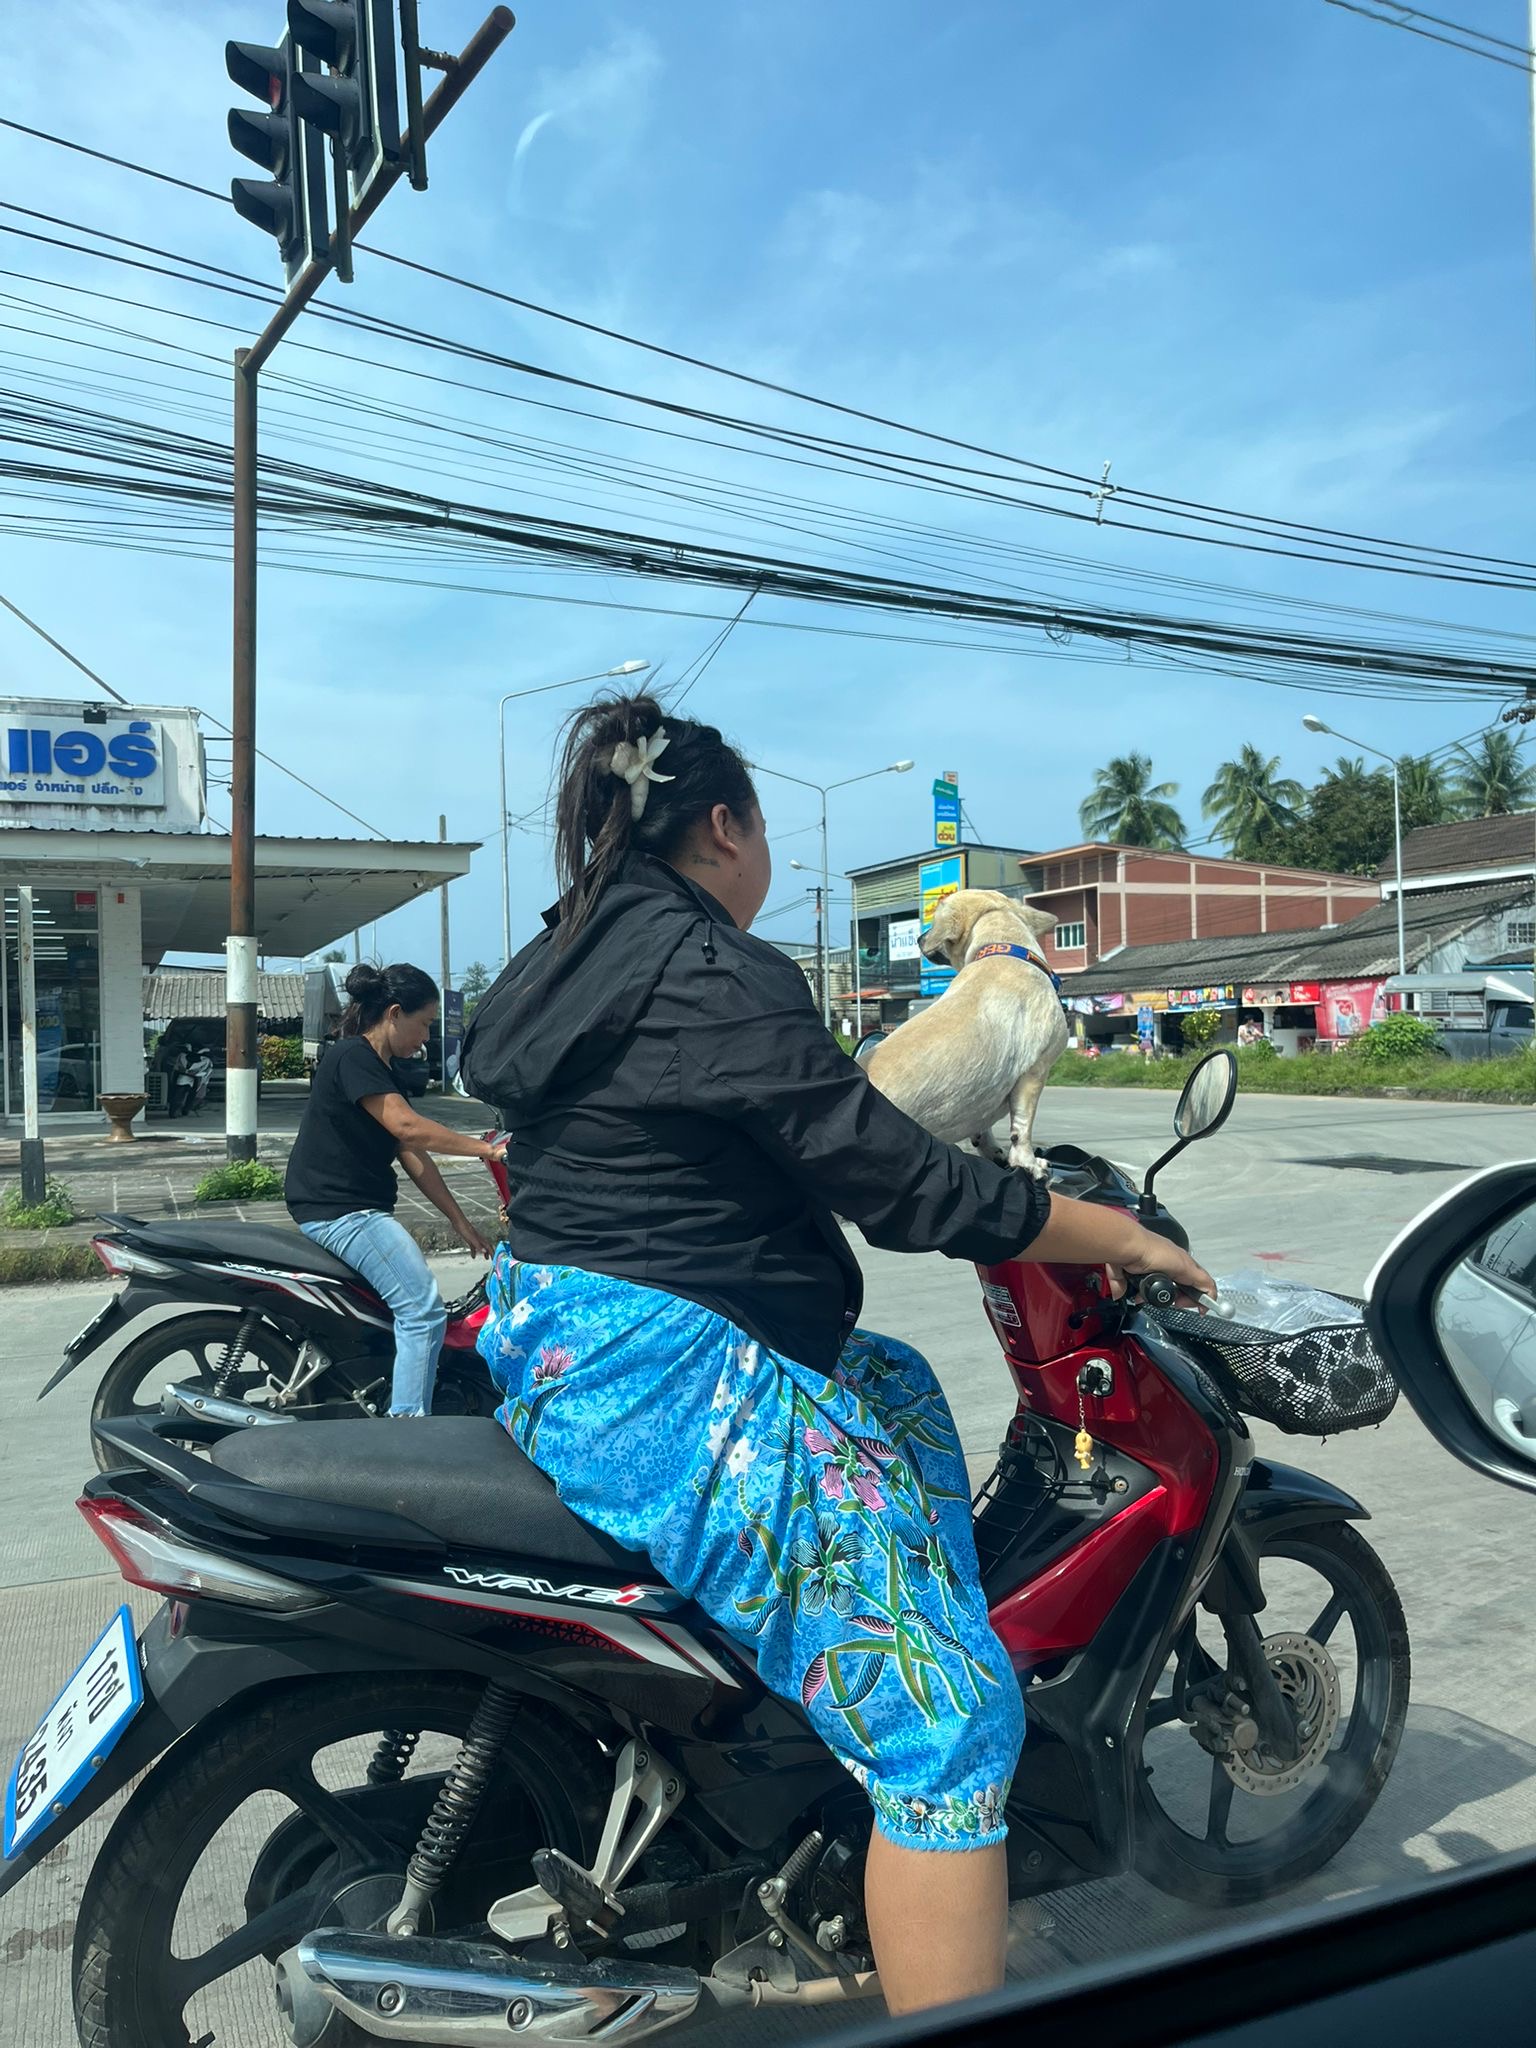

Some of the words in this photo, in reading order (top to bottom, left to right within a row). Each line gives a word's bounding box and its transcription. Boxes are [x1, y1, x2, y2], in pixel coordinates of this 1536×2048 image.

[8, 721, 157, 779] แอร์
[34, 779, 85, 794] จำหน่าย
[15, 1721, 48, 1821] 2435
